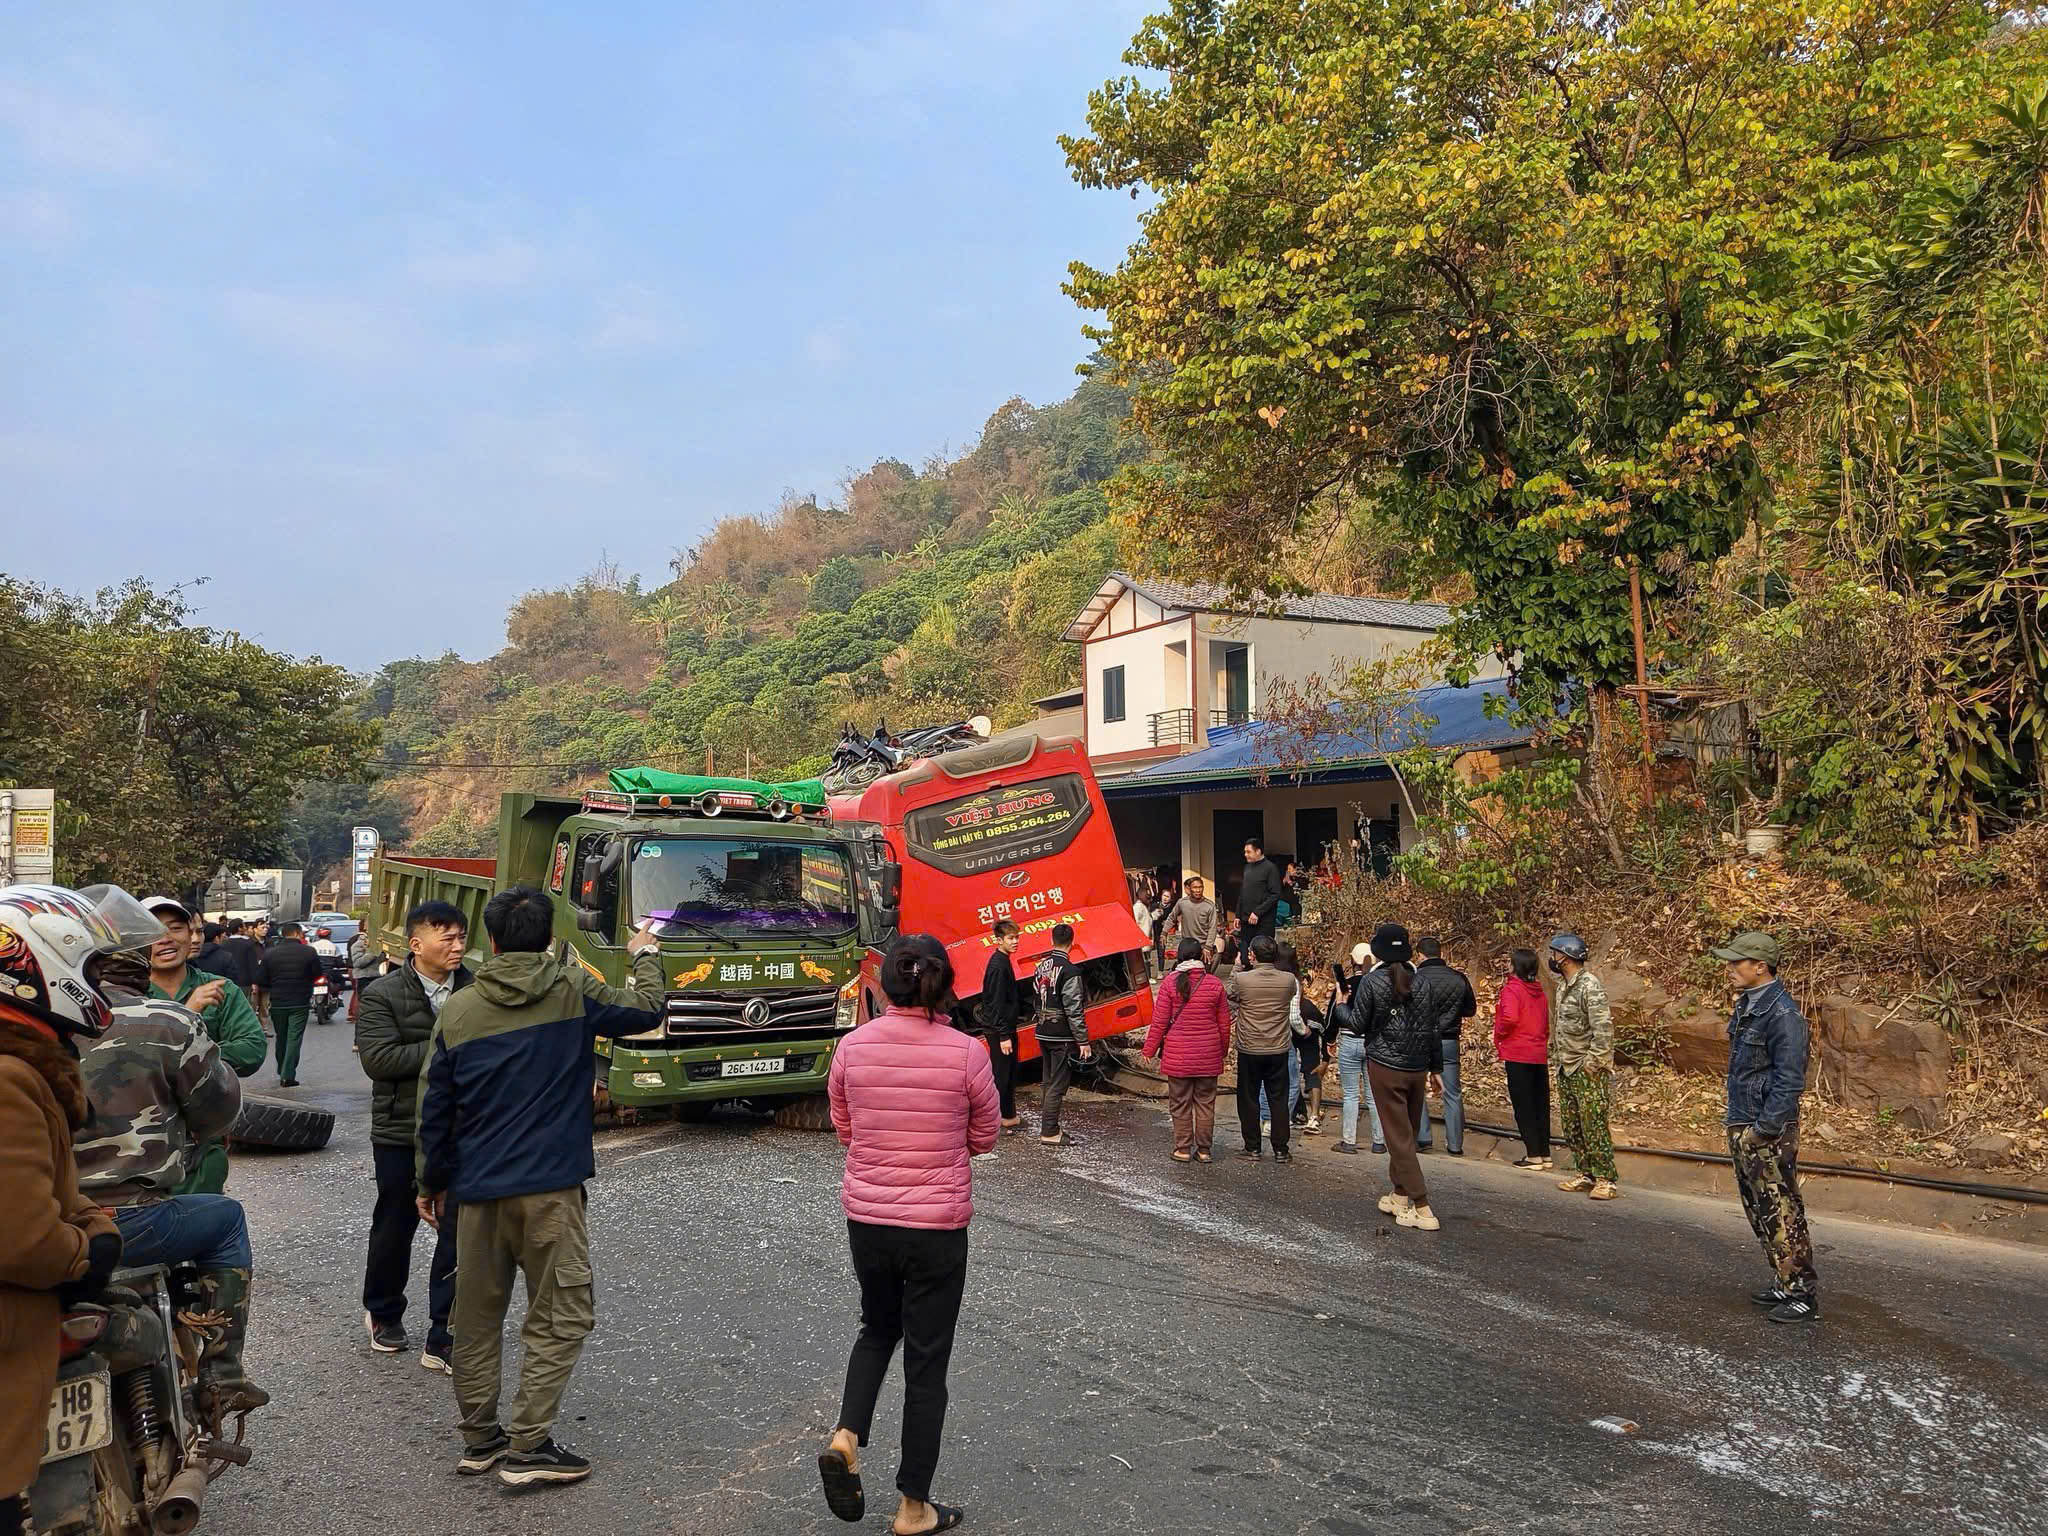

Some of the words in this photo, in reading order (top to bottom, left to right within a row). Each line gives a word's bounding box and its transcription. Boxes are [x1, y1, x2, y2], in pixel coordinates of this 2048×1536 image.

[945, 806, 993, 827] VIỆT
[998, 792, 1055, 816] HƯNG
[986, 809, 1071, 837] 0855.264.264
[965, 841, 1054, 869] UNIVERSE
[980, 912, 1086, 948] 15-09281
[61, 980, 90, 1005] INDEX
[727, 1061, 780, 1074] 26C-142.12
[57, 1413, 93, 1451] 67
